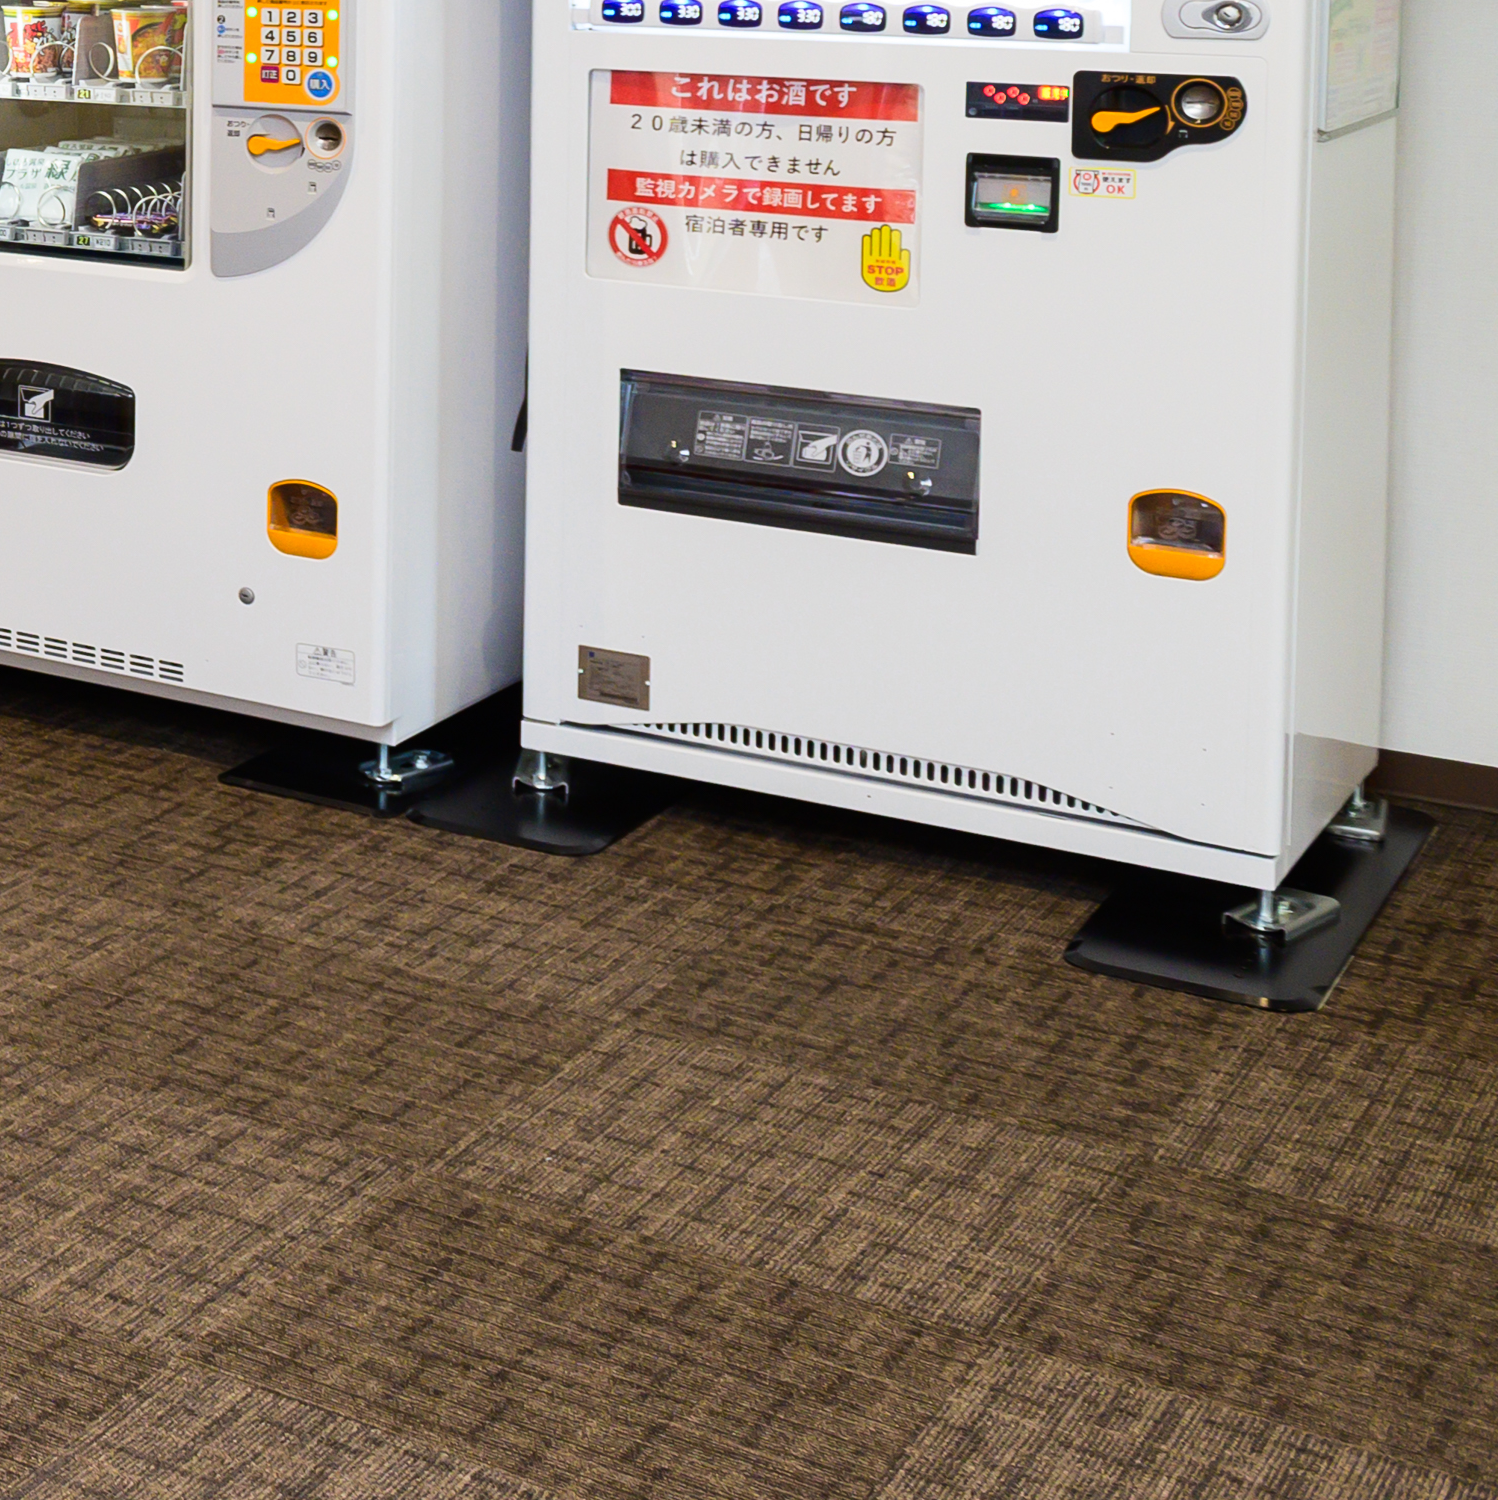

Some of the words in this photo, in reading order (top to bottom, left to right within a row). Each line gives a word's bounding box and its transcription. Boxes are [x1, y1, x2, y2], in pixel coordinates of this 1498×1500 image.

[620, 3, 642, 16] 300
[678, 5, 700, 18] 330
[737, 7, 759, 20] 330
[266, 10, 273, 22] 1
[286, 11, 297, 23] 2
[308, 12, 318, 24] 3
[797, 9, 820, 23] 330
[265, 30, 275, 42] 4
[286, 31, 296, 42] 5
[308, 31, 318, 43] 6
[265, 49, 275, 61] 7
[286, 50, 296, 62] 8
[308, 51, 318, 63] 9
[261, 69, 278, 79] 訂正
[286, 69, 296, 81] 0
[1101, 74, 1156, 84] おつり・返却
[309, 79, 330, 90] 購入
[77, 89, 90, 99] 21
[670, 75, 857, 108] これはお酒です
[630, 113, 898, 147] ２０歳未満の方、日帰りの方
[679, 150, 841, 177] は購入できません
[7, 167, 42, 180] プラザ
[634, 177, 882, 213] 監視カメラで録画してます
[1106, 184, 1126, 194] OK
[685, 215, 829, 243] 宿泊者専用です
[76, 236, 90, 246] 27
[867, 264, 904, 276] STOP
[874, 276, 896, 287] 飲酒
